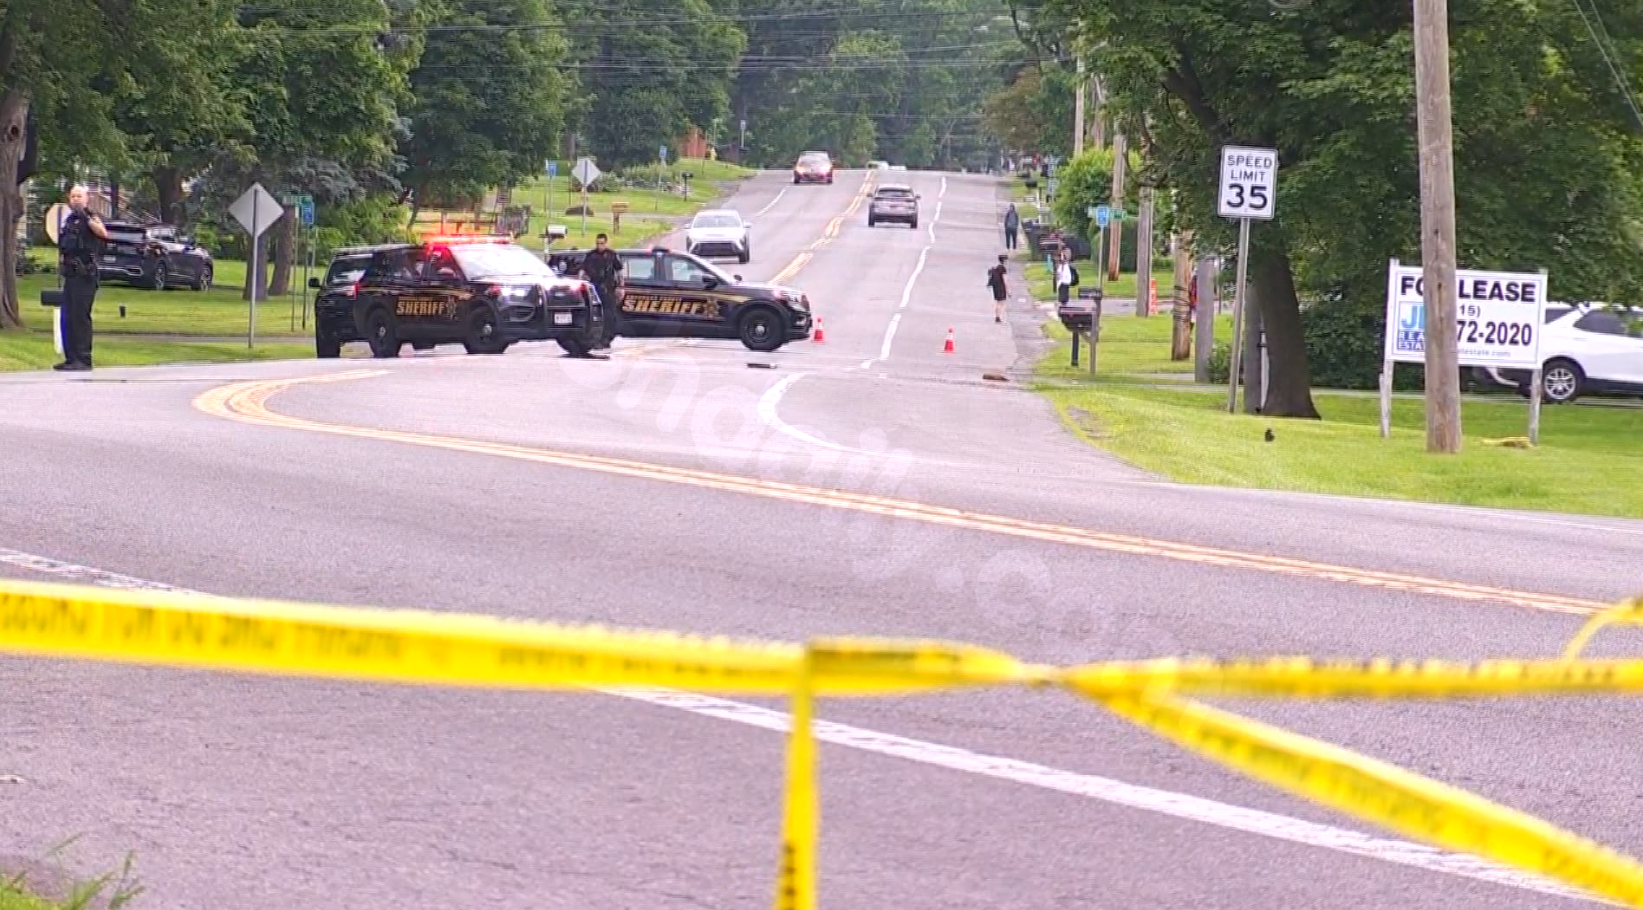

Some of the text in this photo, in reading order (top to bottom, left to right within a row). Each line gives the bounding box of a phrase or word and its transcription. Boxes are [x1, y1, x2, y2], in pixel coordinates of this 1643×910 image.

[1227, 155, 1272, 169] SPEED
[1230, 169, 1266, 182] LIMIT
[1226, 183, 1268, 211] 35
[1401, 276, 1536, 302] FO LEASE
[396, 301, 445, 315] SHERIFF
[622, 299, 704, 316] SHERIFF
[1459, 304, 1481, 318] 15)
[1399, 331, 1425, 341] REA
[1456, 319, 1532, 346] 72-2020
[1398, 341, 1426, 351] ESTA
